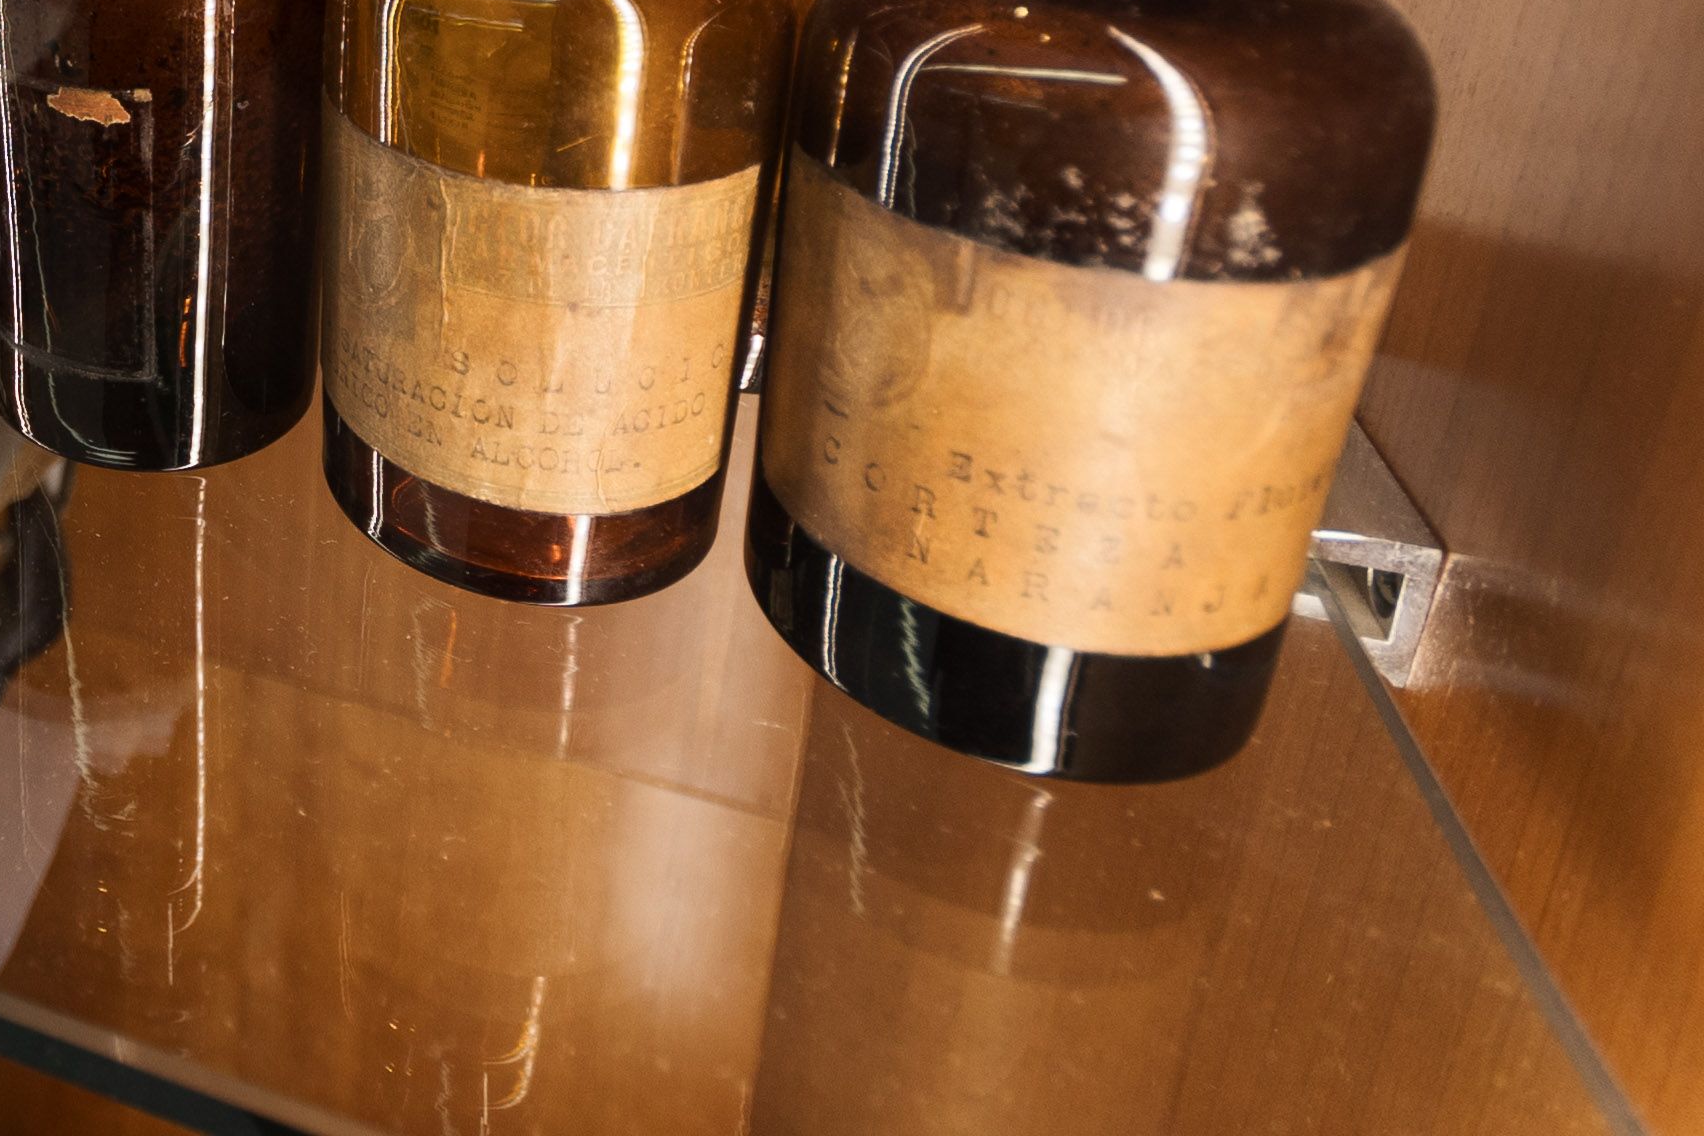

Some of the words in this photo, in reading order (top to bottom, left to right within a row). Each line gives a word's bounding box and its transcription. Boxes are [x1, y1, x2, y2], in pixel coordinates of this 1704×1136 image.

[407, 417, 445, 447] EN
[537, 411, 585, 438] DE
[612, 392, 707, 437] ACIDO
[948, 449, 1198, 524] Extracto
